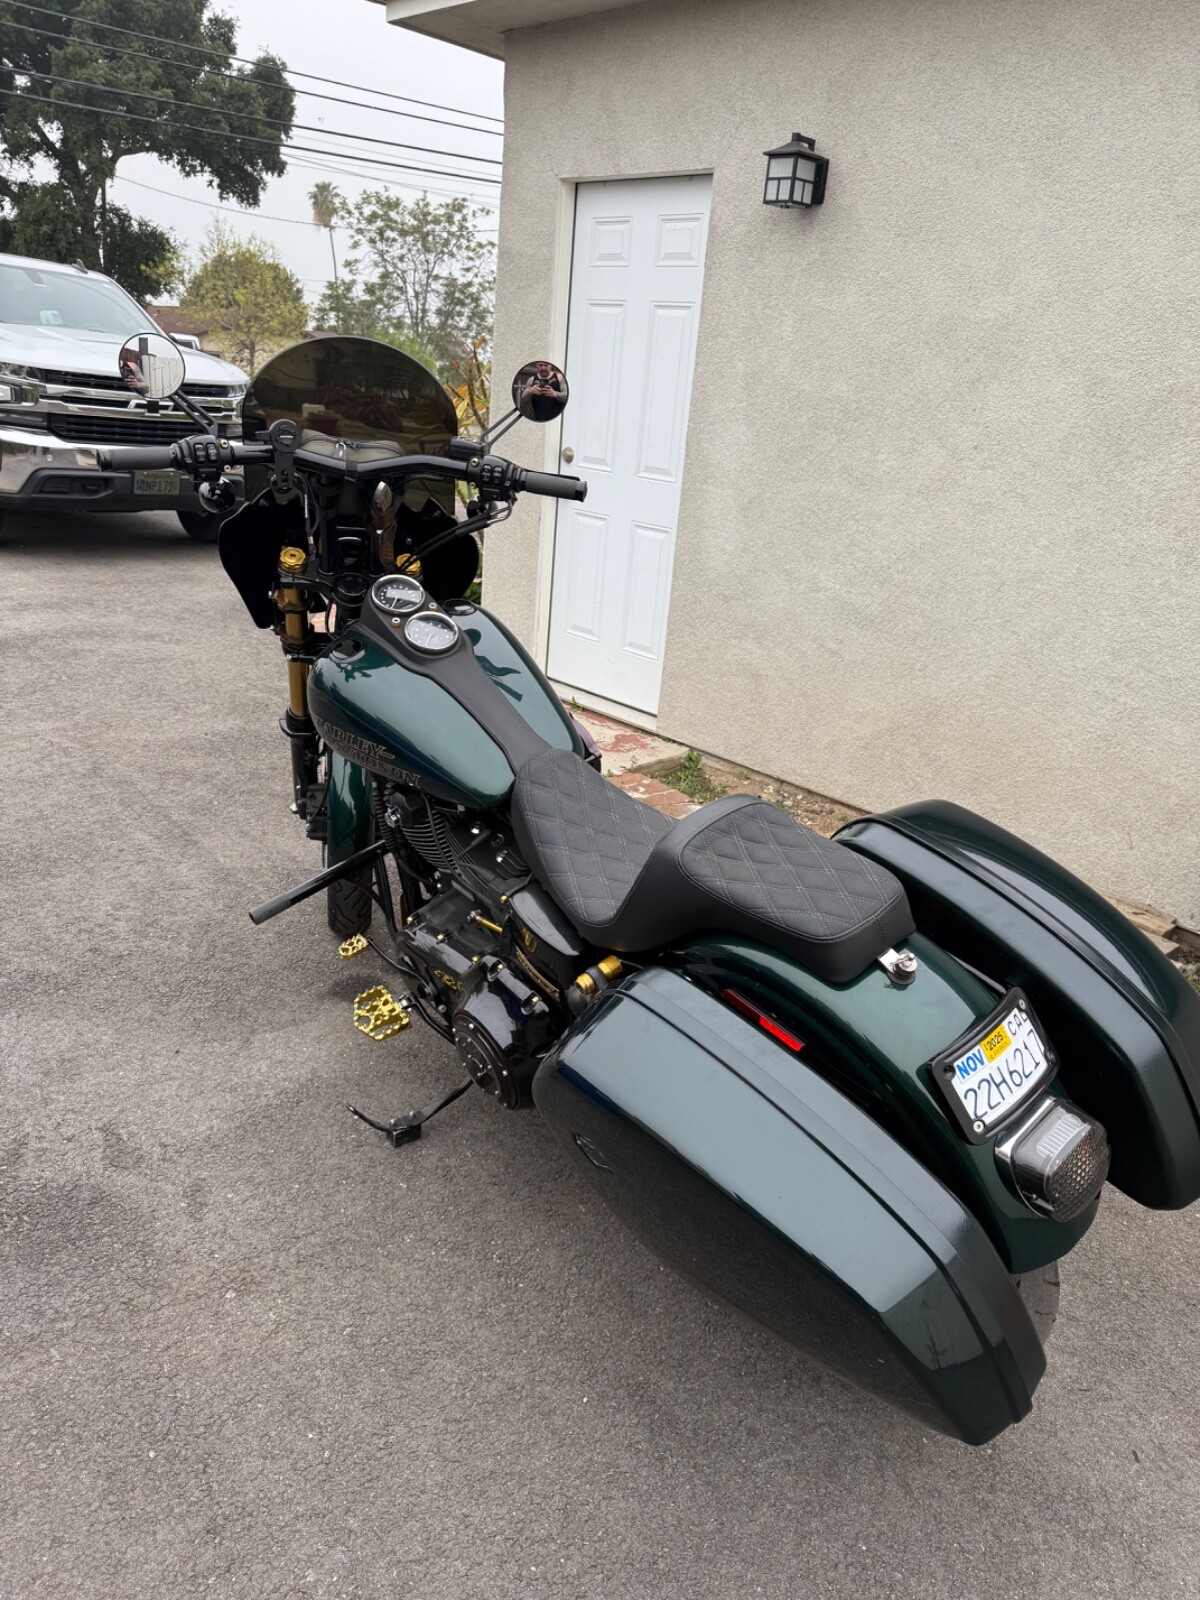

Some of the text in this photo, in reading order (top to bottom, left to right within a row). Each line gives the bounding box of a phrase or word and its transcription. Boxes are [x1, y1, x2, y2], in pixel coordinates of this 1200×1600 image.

[956, 1049, 985, 1080] NOV
[986, 1031, 1004, 1052] 2025
[964, 1028, 1045, 1119] 22H6217
